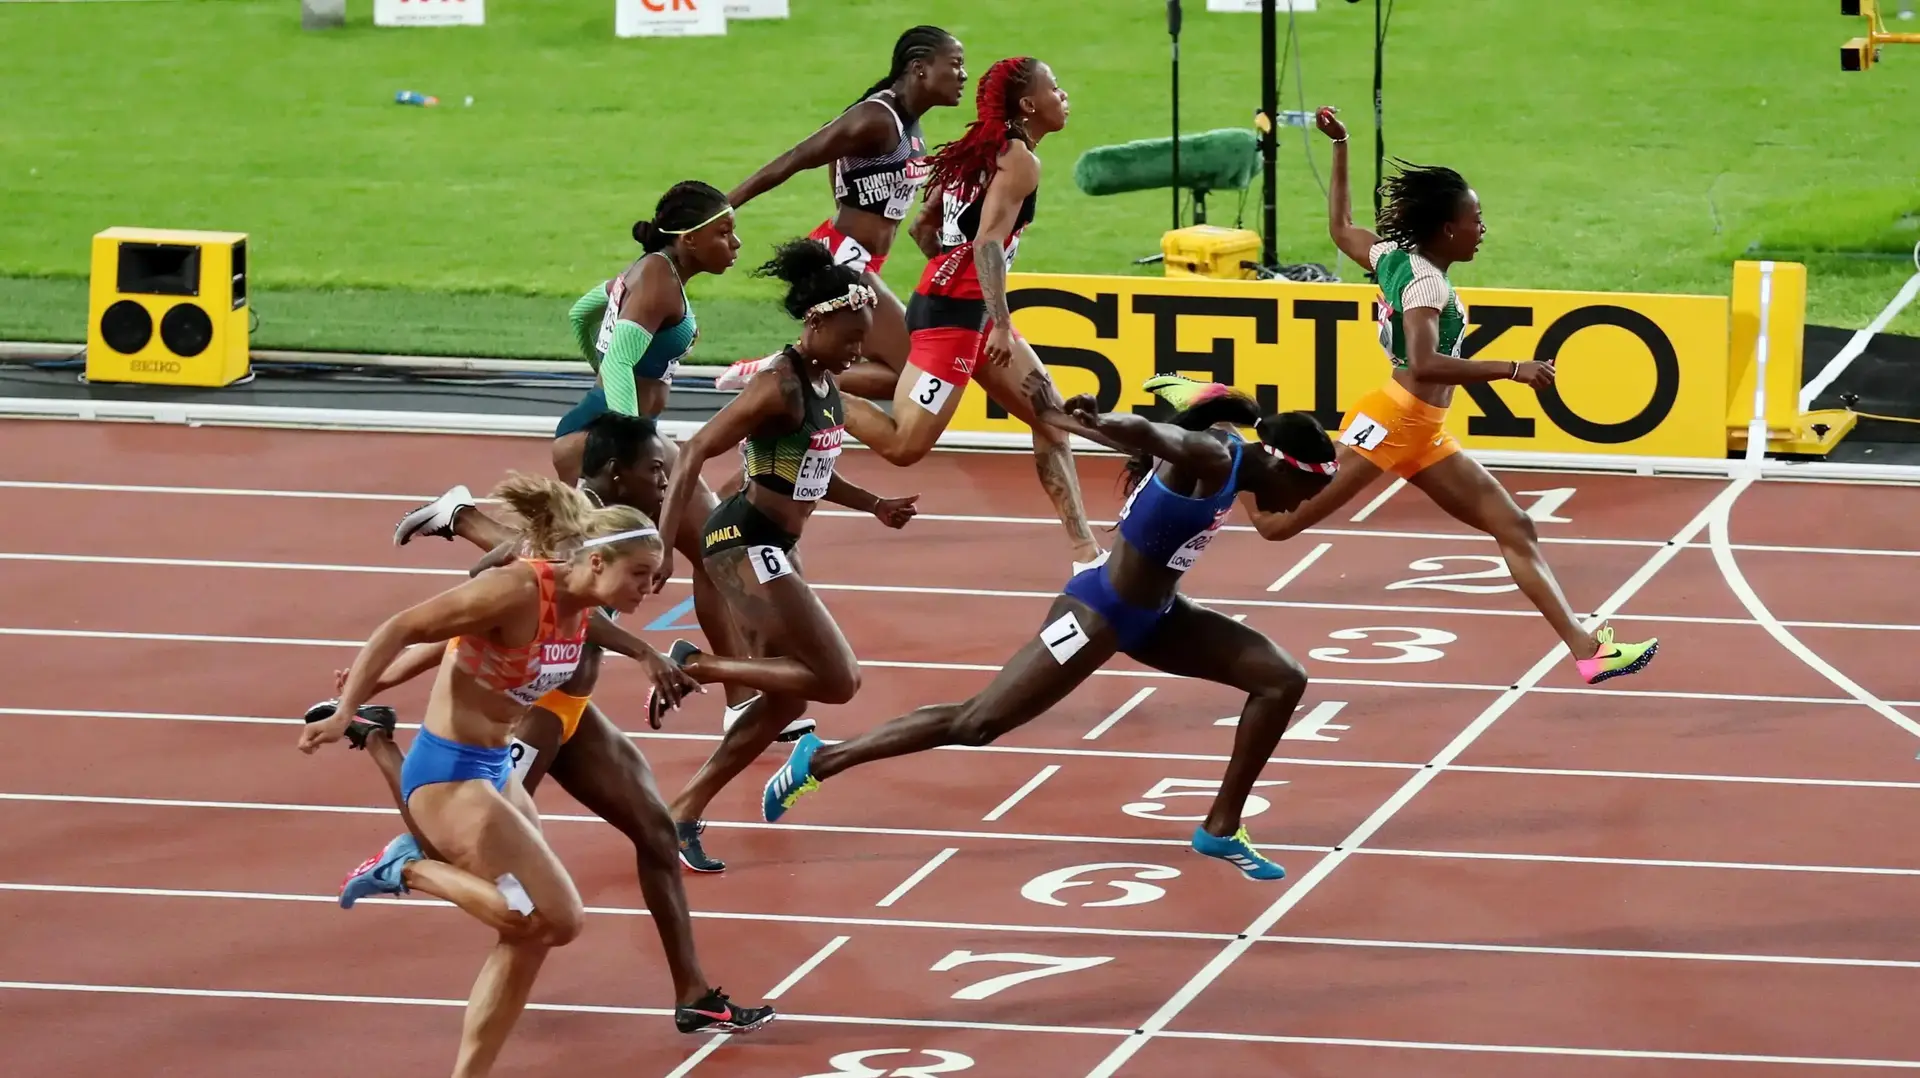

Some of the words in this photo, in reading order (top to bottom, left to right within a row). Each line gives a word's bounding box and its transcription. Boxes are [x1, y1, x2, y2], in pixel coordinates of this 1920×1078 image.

[843, 245, 863, 266] 2
[130, 359, 181, 374] SEIKO
[985, 287, 1680, 445] SEIKO
[918, 377, 942, 405] 3
[1351, 423, 1375, 446] 4
[1517, 487, 1577, 524] 1
[705, 525, 742, 549] JAMAICA
[760, 546, 782, 576] 6
[1386, 555, 1519, 594] 2
[1049, 621, 1082, 648] 7
[1309, 626, 1458, 664] 3
[1213, 701, 1352, 742] 4
[1121, 777, 1291, 821] 5
[1021, 862, 1182, 907] 6
[929, 950, 1114, 1000] 7
[798, 1047, 976, 1078] 8
